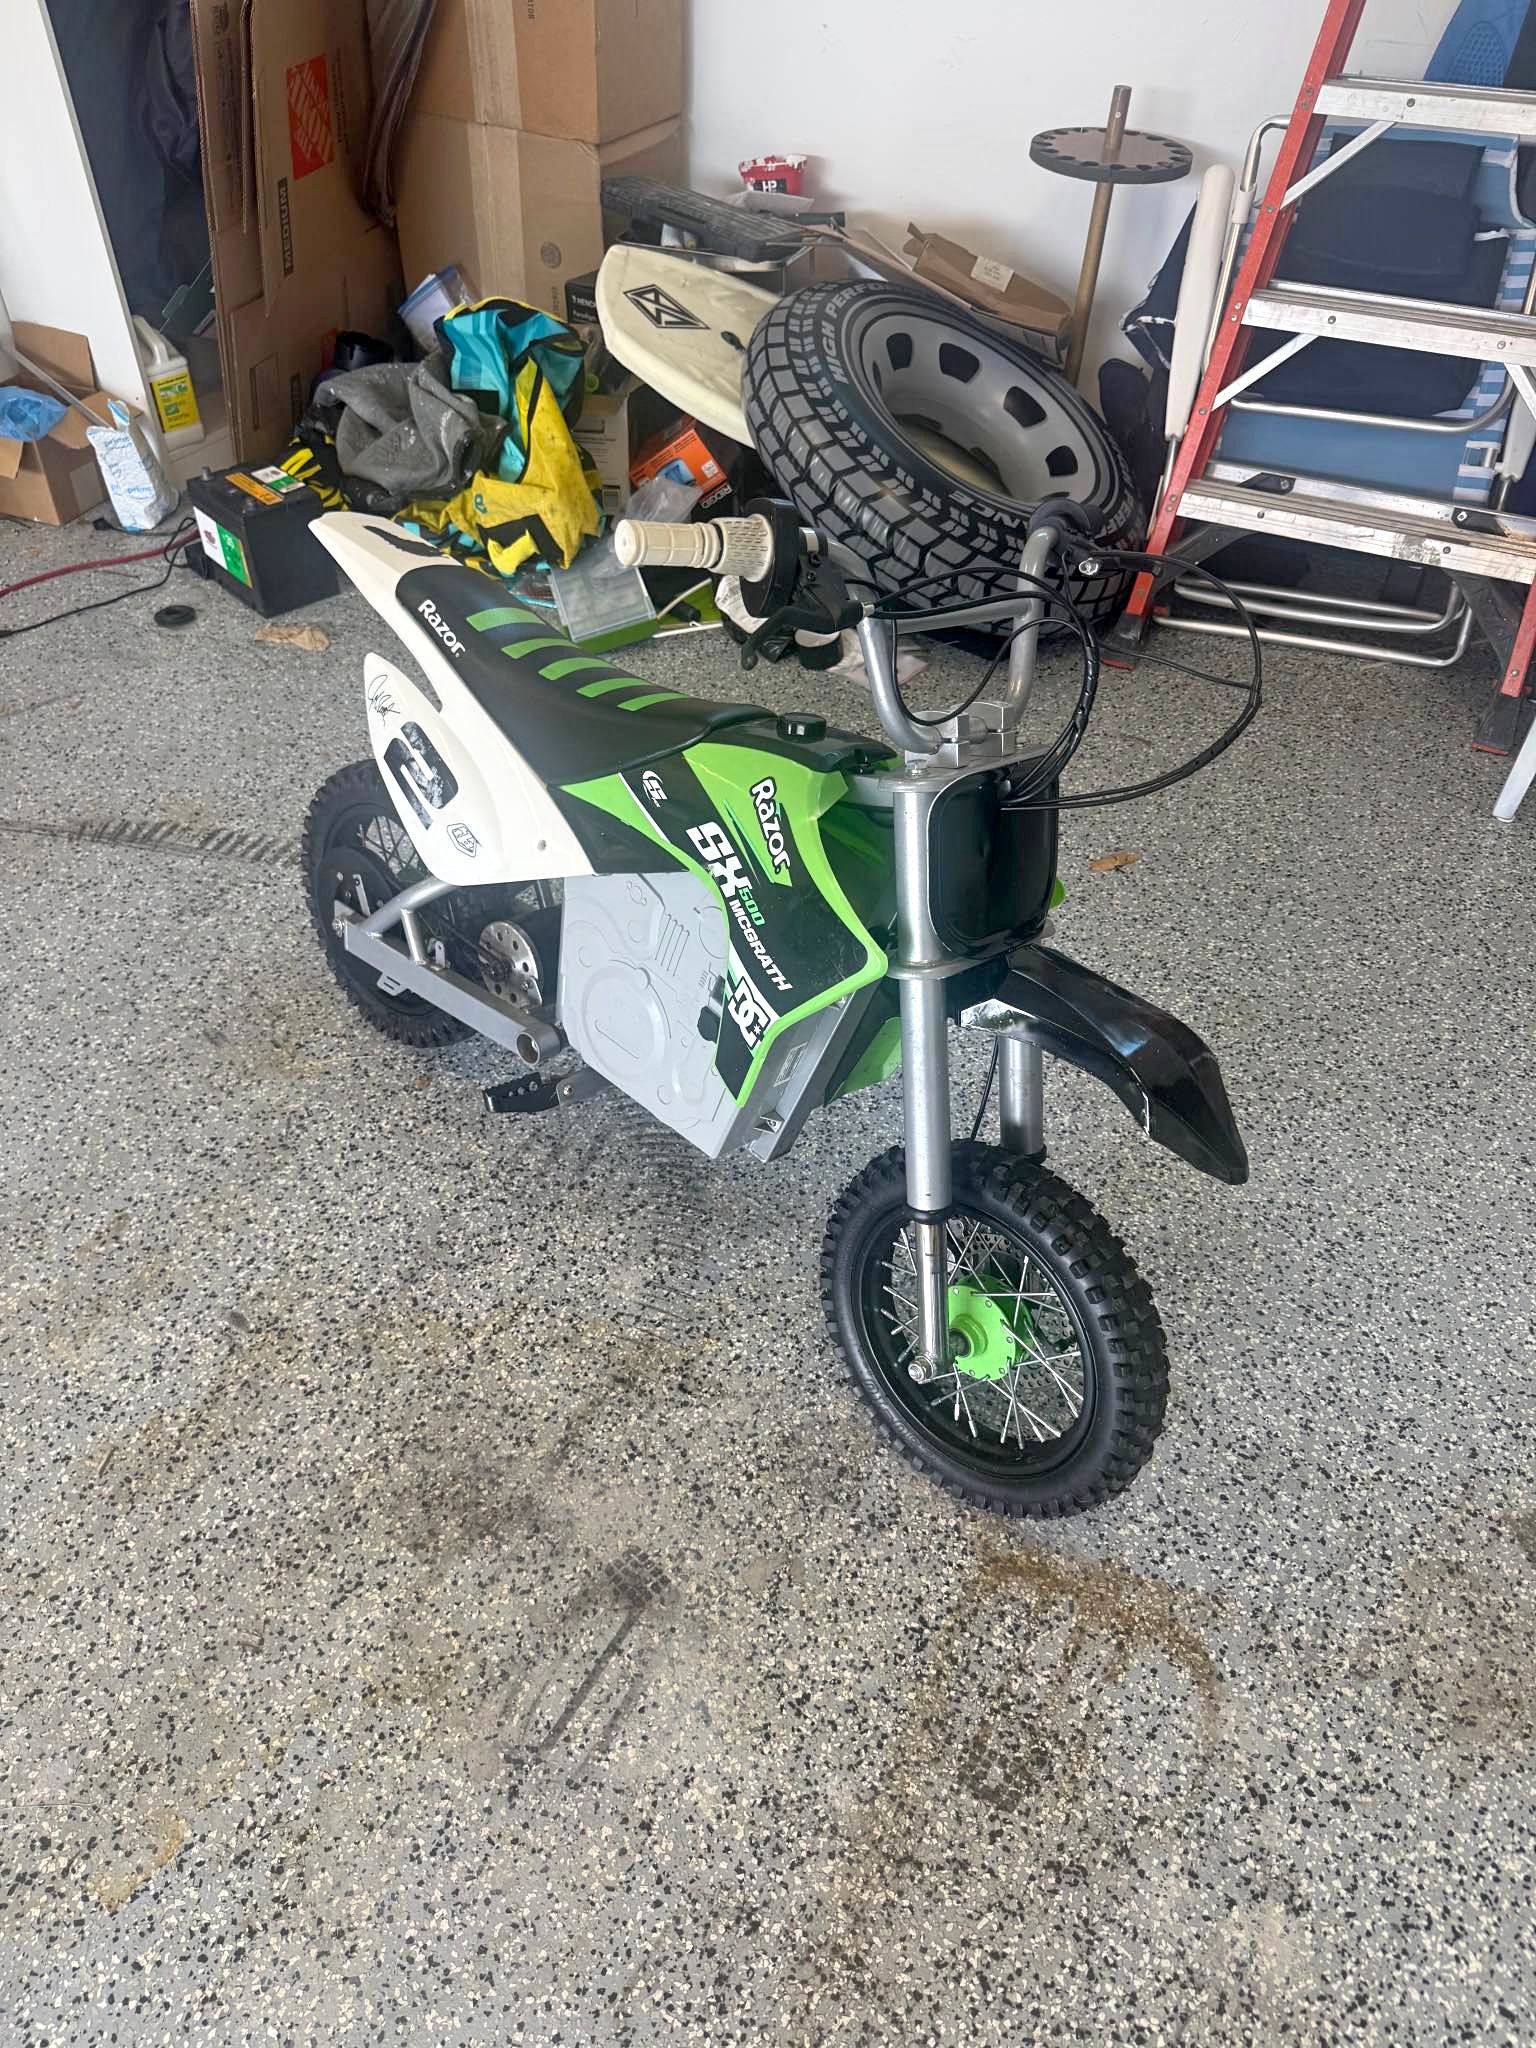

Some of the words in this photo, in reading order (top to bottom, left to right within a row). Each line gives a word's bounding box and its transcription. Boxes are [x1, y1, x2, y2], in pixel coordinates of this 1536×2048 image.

[278, 185, 292, 270] MEDIUM
[822, 320, 849, 384] HIGH
[738, 887, 766, 926] 500
